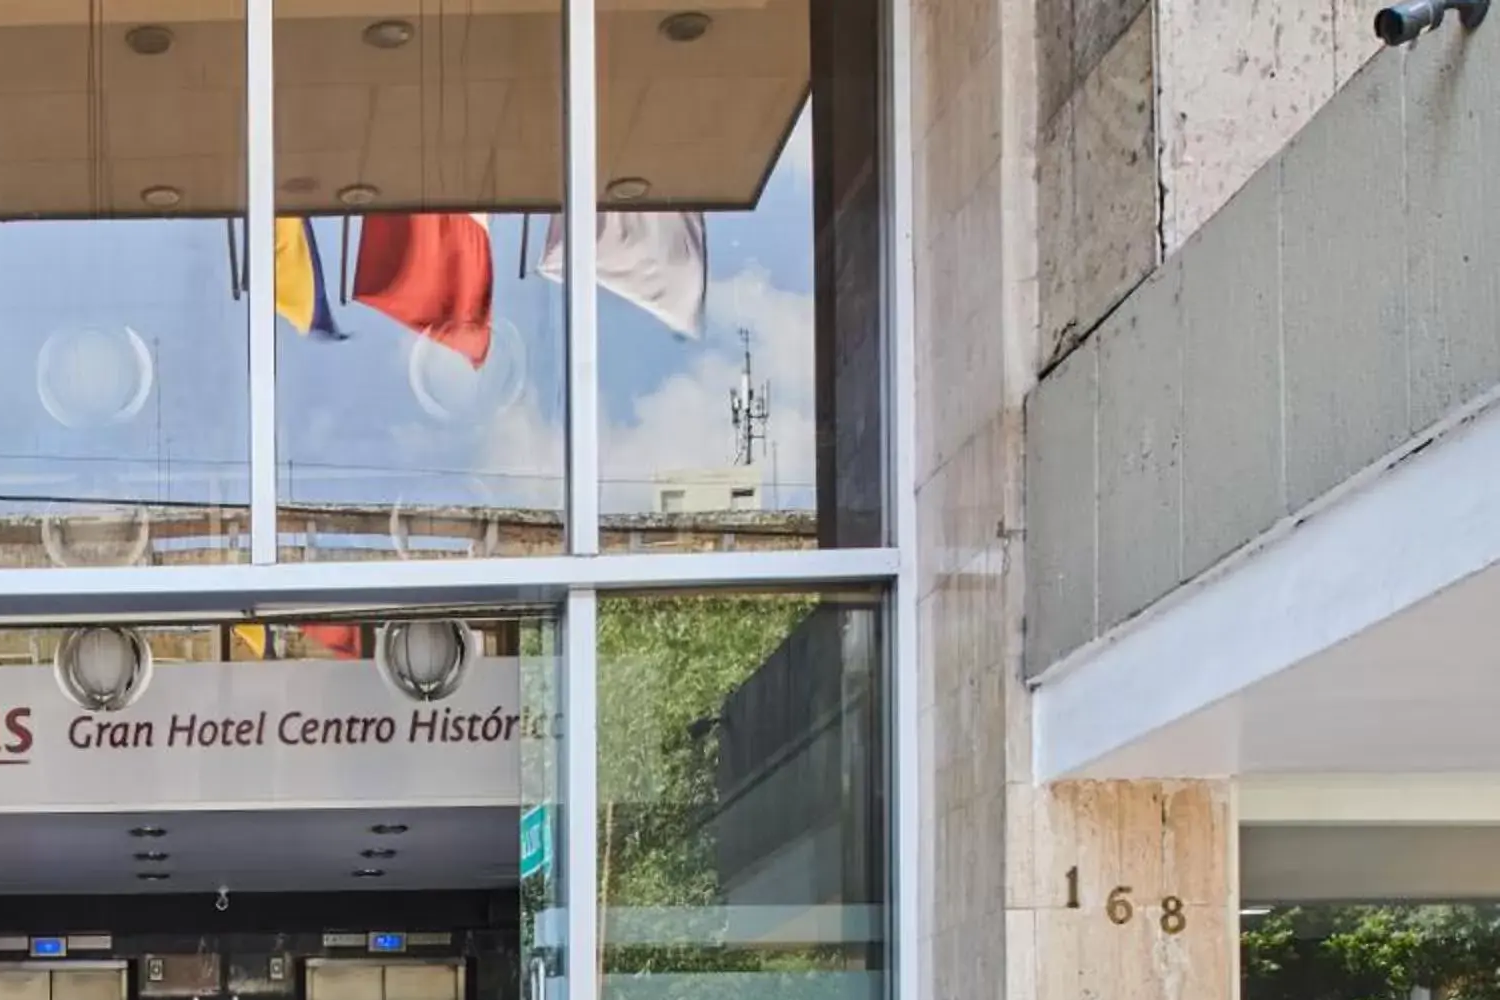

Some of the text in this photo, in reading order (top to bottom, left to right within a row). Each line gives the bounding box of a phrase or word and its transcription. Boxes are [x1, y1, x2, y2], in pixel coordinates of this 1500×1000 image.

[68, 714, 154, 749] Gran
[167, 711, 267, 747] Hotel
[277, 710, 396, 745] Centro
[1065, 864, 1187, 935] 168
